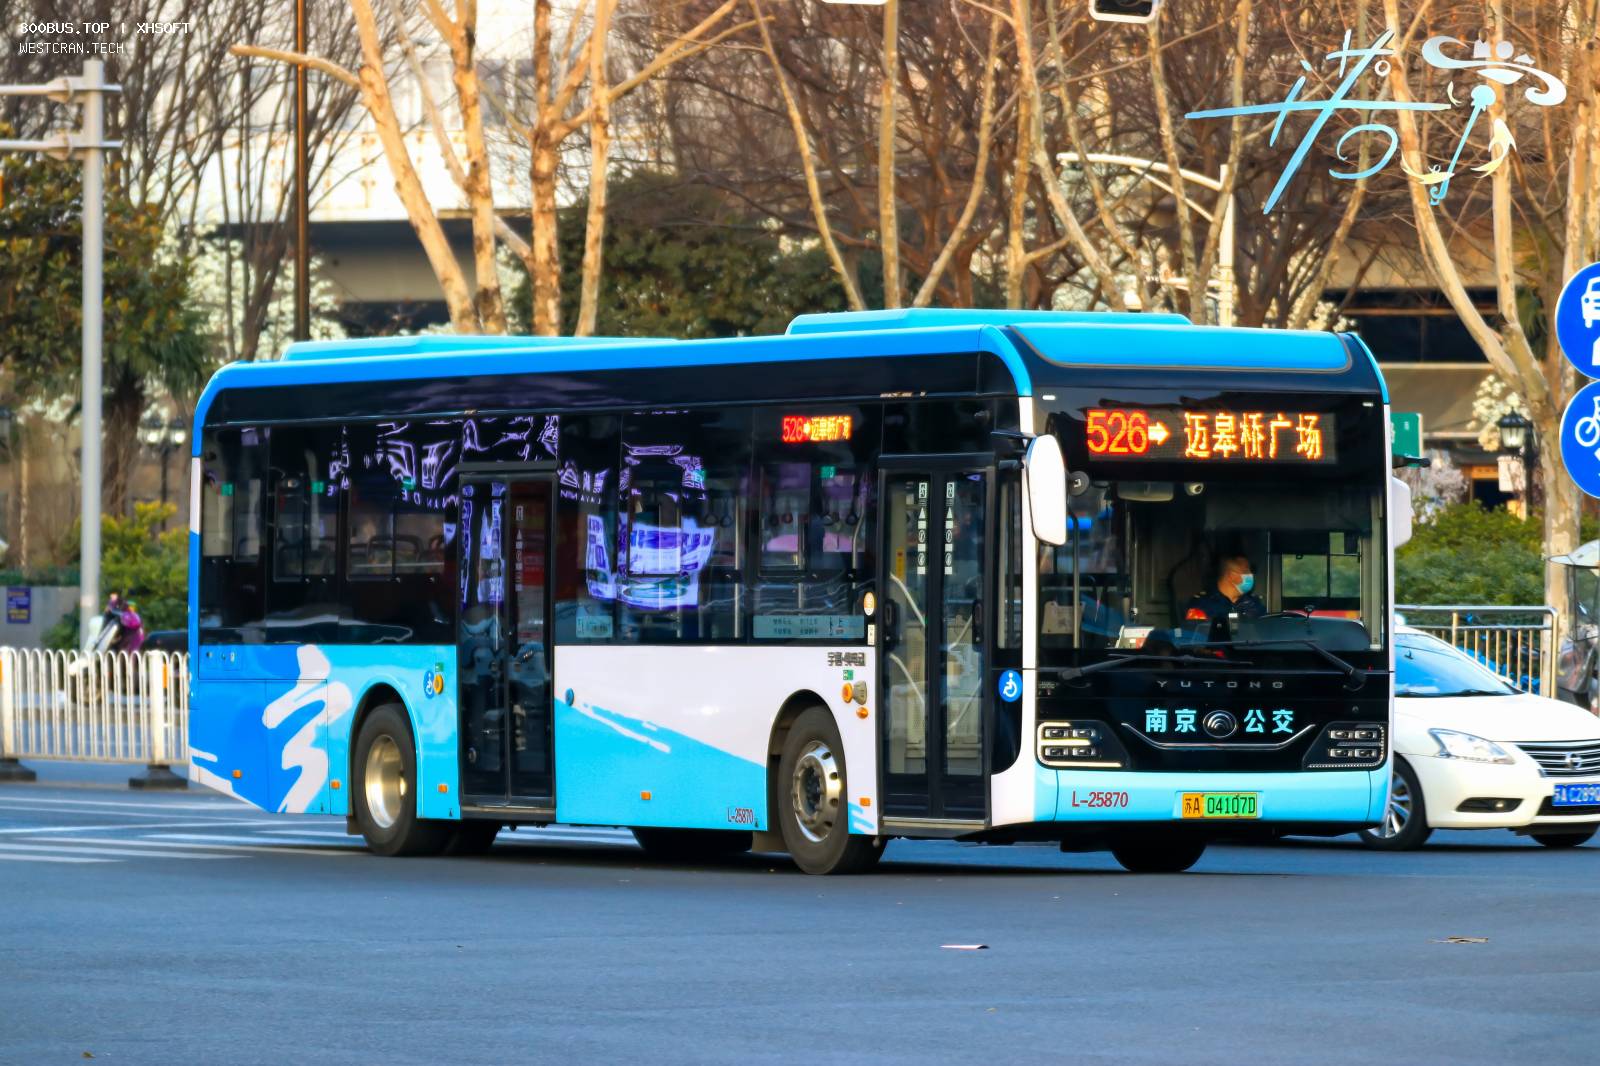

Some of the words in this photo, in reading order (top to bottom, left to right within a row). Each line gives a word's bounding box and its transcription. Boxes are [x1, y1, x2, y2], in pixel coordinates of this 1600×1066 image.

[782, 416, 804, 442] 526
[1086, 409, 1148, 454] 526
[1183, 411, 1324, 460] 迈皋桥广场
[1157, 680, 1284, 689] YUTONG
[1145, 708, 1197, 733] 南京
[1243, 709, 1294, 734] 公交
[1071, 790, 1129, 808] L-25870
[727, 807, 754, 824] L-25870
